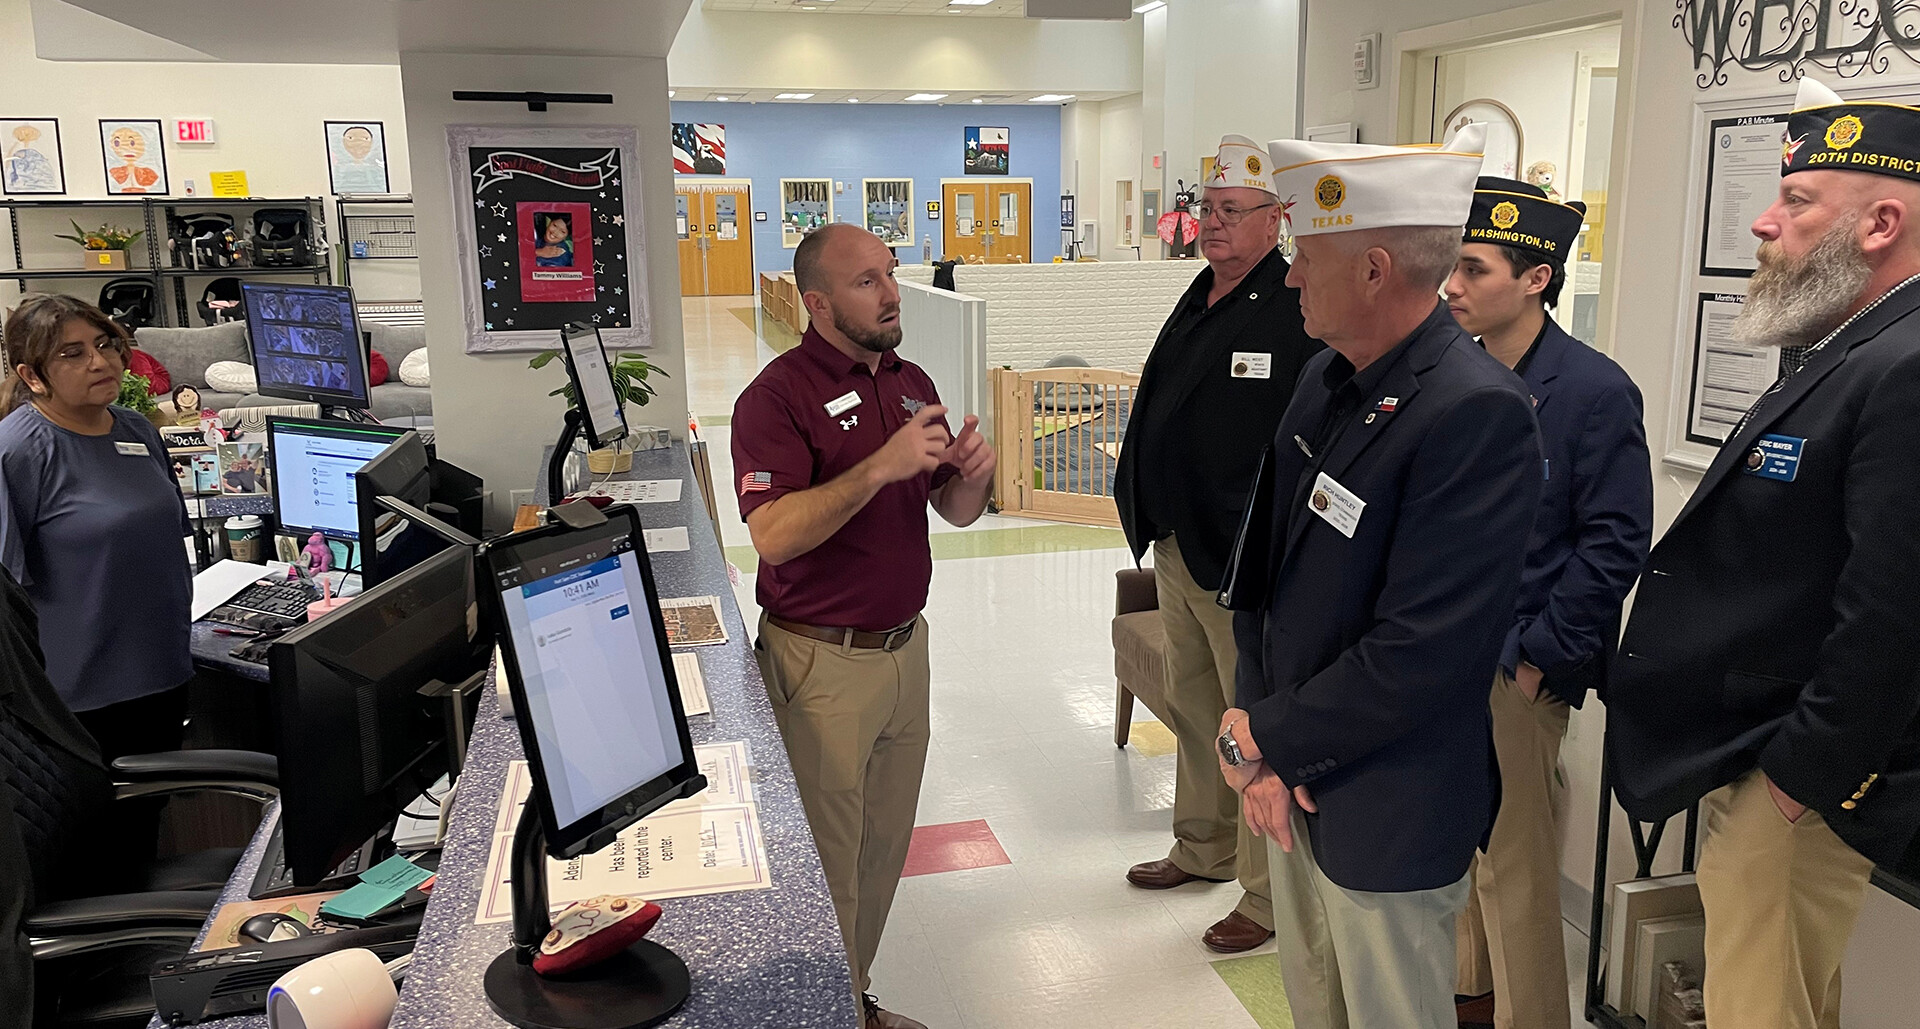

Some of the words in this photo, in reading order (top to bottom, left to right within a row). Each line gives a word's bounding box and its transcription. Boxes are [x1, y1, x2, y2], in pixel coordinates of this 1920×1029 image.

[1754, 116, 1775, 124] Minutes
[178, 121, 205, 141] EXIT
[1808, 152, 1848, 164] 20TH
[1243, 178, 1266, 188] TEXAS
[1312, 214, 1353, 228] TEXAS
[1470, 229, 1542, 248] WASHINGTON,
[1544, 240, 1556, 251] DC
[1714, 294, 1736, 303] Monthly
[1758, 440, 1773, 448] ERIC
[1773, 442, 1793, 451] MAYER
[1323, 484, 1335, 496] RICH
[1334, 492, 1356, 510] HUNTLEY
[562, 581, 585, 598] 10:41
[585, 578, 600, 591] AM
[637, 825, 649, 837] the
[635, 838, 649, 848] in
[659, 835, 674, 861] center.
[609, 856, 625, 872] Has
[637, 848, 653, 879] reported
[703, 849, 716, 867] Date:
